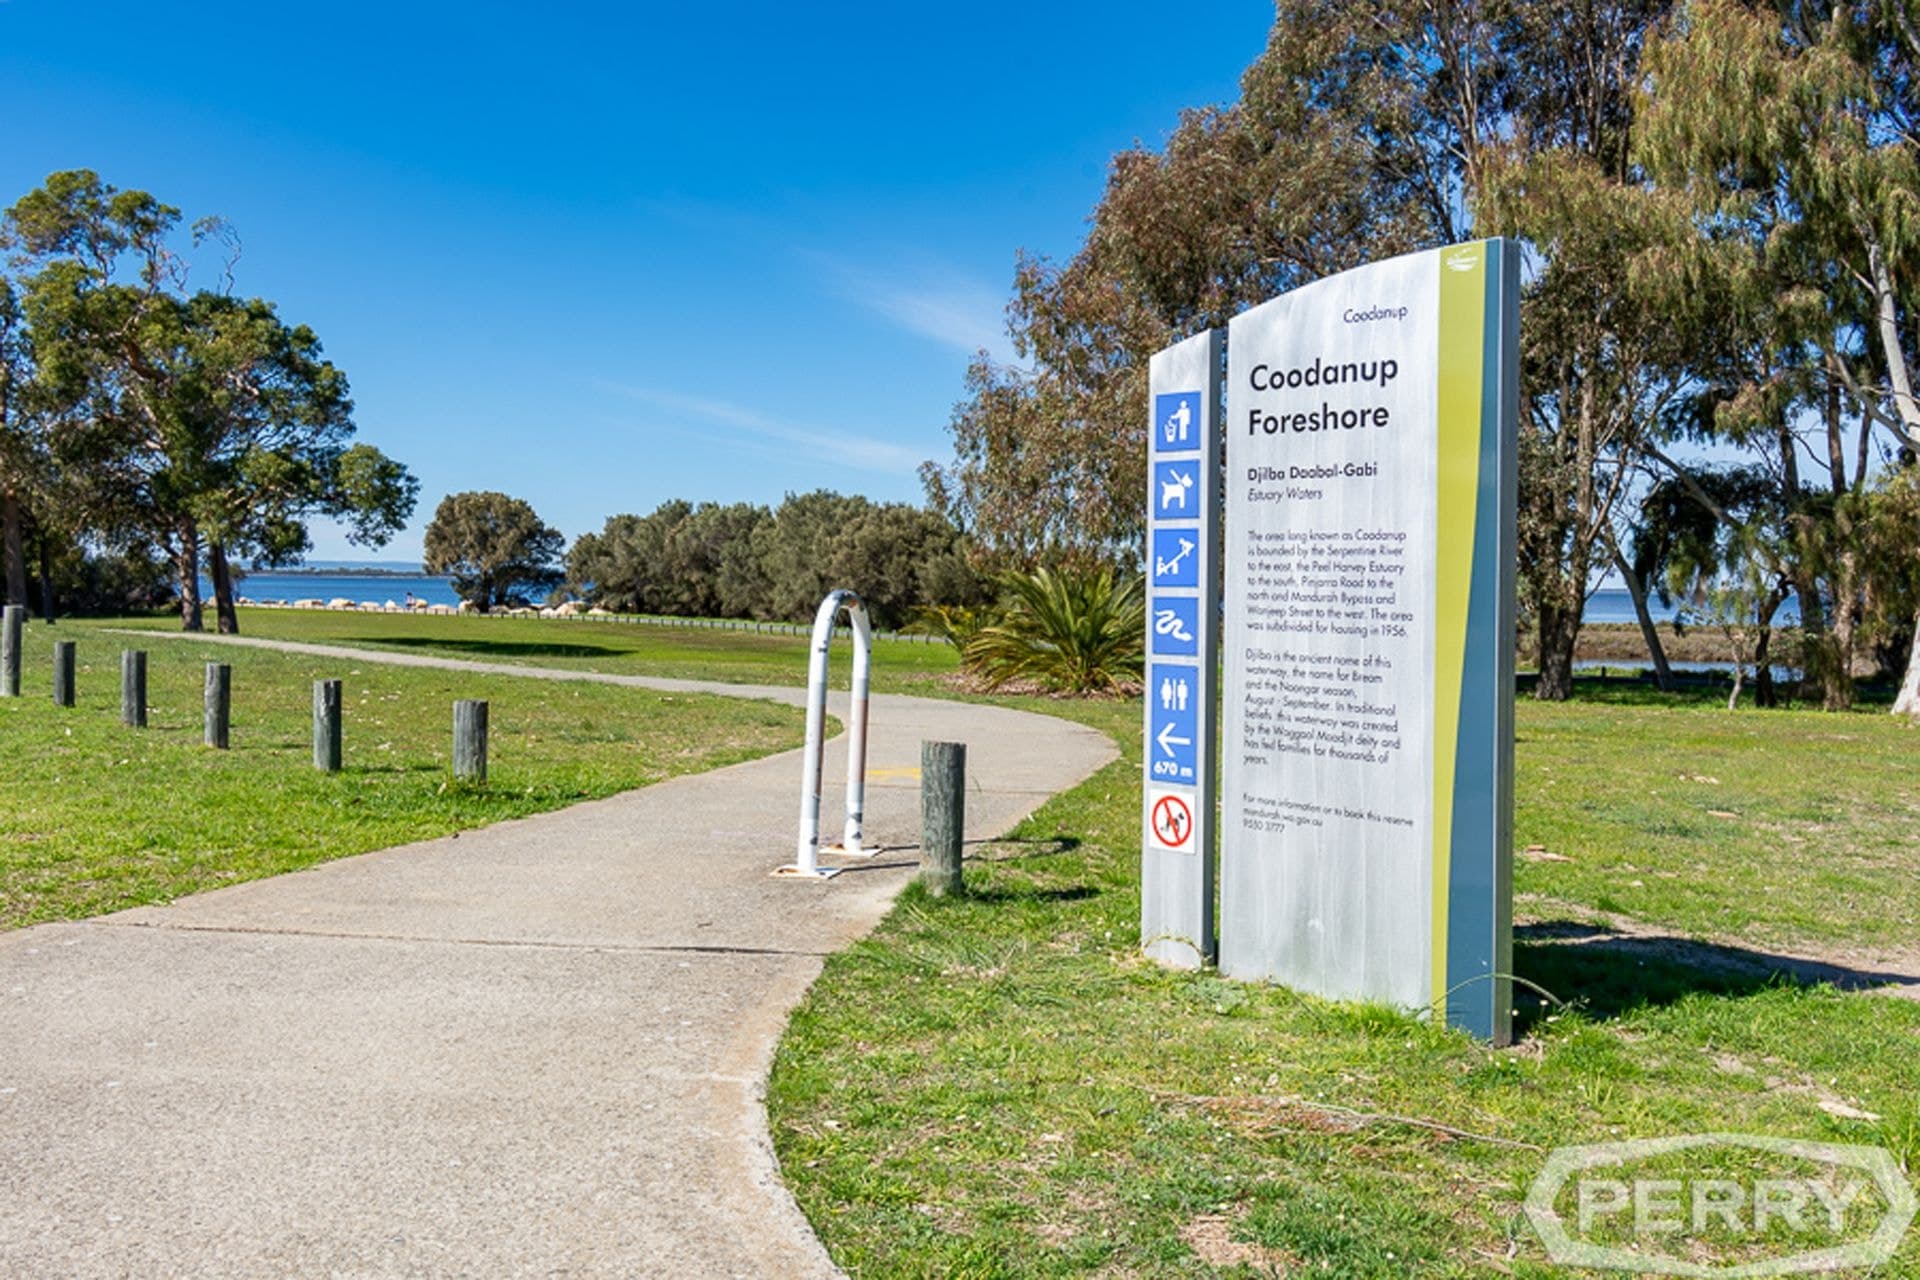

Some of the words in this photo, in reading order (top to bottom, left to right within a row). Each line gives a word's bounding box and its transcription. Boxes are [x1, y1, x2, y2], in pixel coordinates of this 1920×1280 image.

[1343, 305, 1409, 324] Coodanup
[1250, 358, 1398, 392] Coodanup
[1248, 403, 1390, 435] Foreshore
[1247, 467, 1285, 484] Djilba
[1247, 487, 1284, 504] Estuary
[1287, 486, 1323, 500] Waters
[1248, 530, 1262, 541] The
[1265, 533, 1284, 541] area
[1288, 529, 1307, 544] long
[1309, 530, 1339, 541] known
[1355, 529, 1406, 543] Coodanup
[1248, 546, 1255, 556] is
[1256, 544, 1295, 556] bounded
[1297, 544, 1308, 558] by
[1311, 546, 1325, 555] the
[1327, 544, 1376, 559] Serpentine
[1380, 545, 1403, 556] River
[1248, 562, 1256, 571] to
[1258, 560, 1271, 571] the
[1297, 559, 1309, 571] the
[1312, 561, 1331, 572] Peel
[1333, 562, 1365, 575] Harvey
[1369, 561, 1405, 575] Estuary
[1248, 577, 1256, 586] to
[1258, 575, 1271, 586] the
[1340, 576, 1363, 588] Road
[1367, 577, 1376, 588] to
[1380, 576, 1394, 588] the
[1247, 589, 1269, 600] north
[1272, 590, 1289, 601] and
[1291, 592, 1338, 602] Mandurah
[1376, 592, 1395, 604] and
[1316, 609, 1325, 618] to
[1327, 607, 1341, 619] the
[1371, 608, 1387, 620] The
[1390, 612, 1413, 621] area
[1316, 622, 1328, 633] for
[1331, 622, 1368, 638] housing
[1274, 650, 1280, 661] is
[1283, 651, 1296, 661] the
[1333, 656, 1359, 666] name
[1363, 654, 1372, 666] of
[1375, 655, 1391, 668] this
[1293, 666, 1306, 677] the
[1309, 670, 1333, 680] name
[1337, 668, 1349, 681] for
[1246, 679, 1261, 689] and
[1265, 679, 1277, 691] the
[1244, 721, 1254, 736] by
[1258, 723, 1270, 735] the
[1381, 737, 1400, 749] and
[1314, 744, 1326, 756] for
[1154, 761, 1178, 776] 670
[1180, 767, 1193, 777] m
